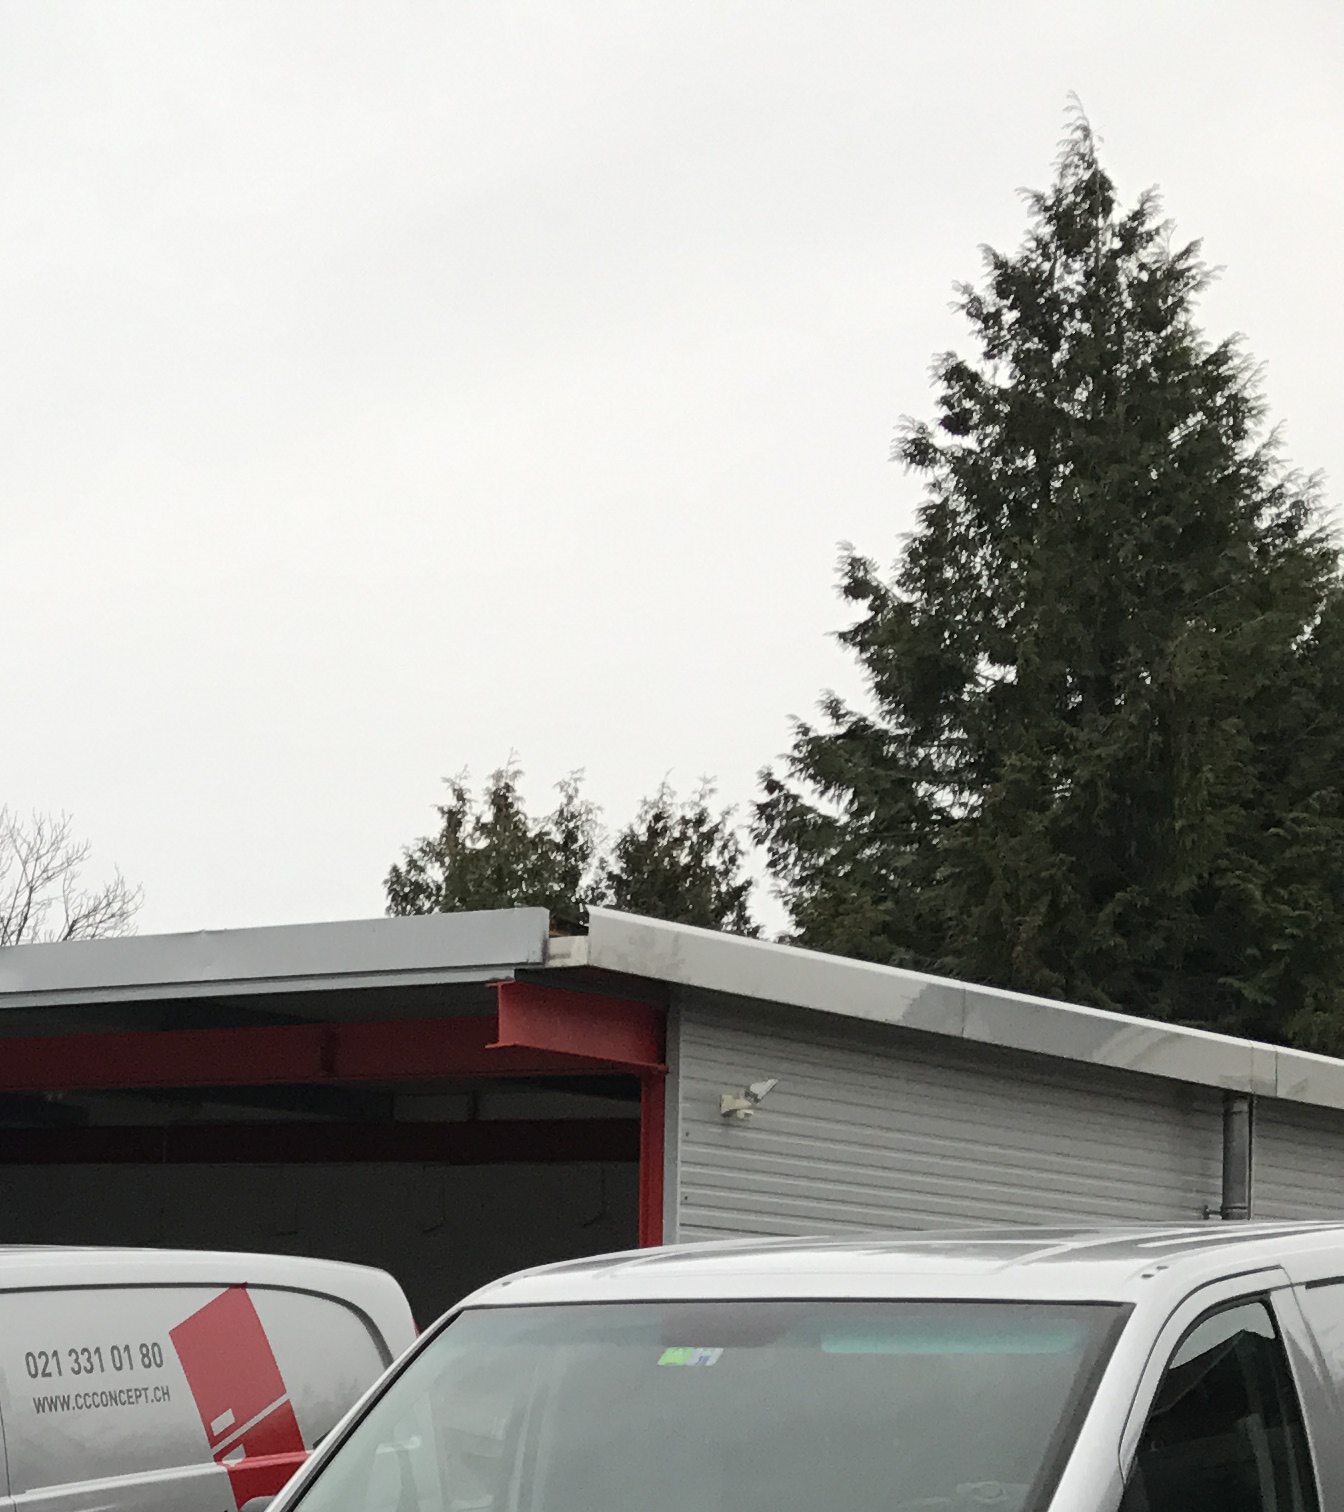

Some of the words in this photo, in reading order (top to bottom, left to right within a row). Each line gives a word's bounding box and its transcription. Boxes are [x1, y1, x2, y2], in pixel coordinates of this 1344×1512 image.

[24, 1349, 63, 1379] 021
[68, 1346, 105, 1375] 331
[110, 1344, 134, 1372] 01
[139, 1342, 164, 1369] 80
[32, 1385, 171, 1414] WWW.CCCONCEPT.CH
